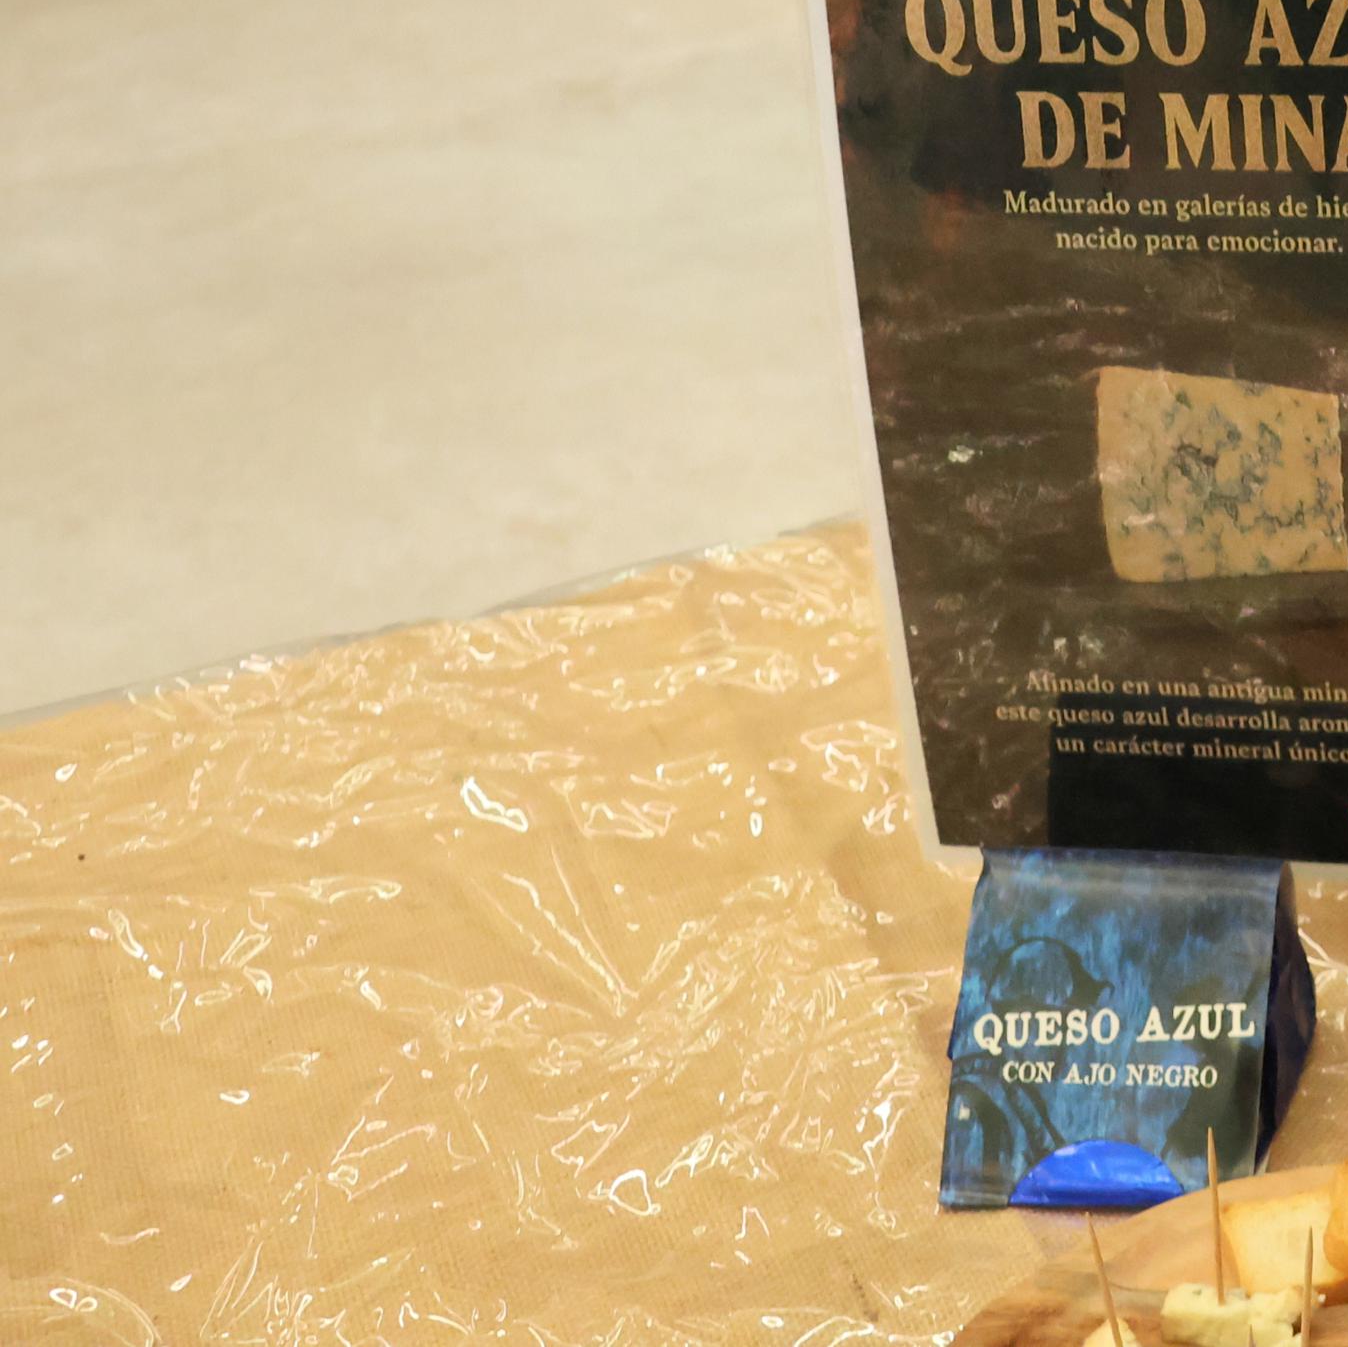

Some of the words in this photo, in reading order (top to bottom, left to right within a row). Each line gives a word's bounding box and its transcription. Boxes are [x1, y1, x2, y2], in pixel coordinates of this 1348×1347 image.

[1016, 91, 1131, 170] DE
[1003, 190, 1130, 214] Madurado
[1138, 198, 1167, 215] en
[1175, 193, 1271, 222] galerías
[1278, 195, 1308, 217] de
[1056, 226, 1137, 249] nacido
[1145, 233, 1199, 255] para
[1207, 228, 1343, 253] emocionar.
[1026, 670, 1114, 694] Afinado
[1122, 679, 1150, 695] en
[1158, 681, 1200, 697] una
[1208, 680, 1295, 705] antigua
[996, 705, 1040, 722] este
[1048, 708, 1114, 727] queso
[1122, 706, 1169, 727] azul
[1177, 707, 1290, 730] desarrolla
[1055, 736, 1084, 753] un
[1093, 735, 1185, 757] carácter
[1192, 739, 1280, 761] mineral
[973, 1007, 1120, 1055] QUESO
[1136, 1003, 1255, 1042] AZUL
[1003, 1060, 1055, 1084] CON
[1064, 1063, 1116, 1086] AJO
[1126, 1064, 1218, 1088] NEGRO
